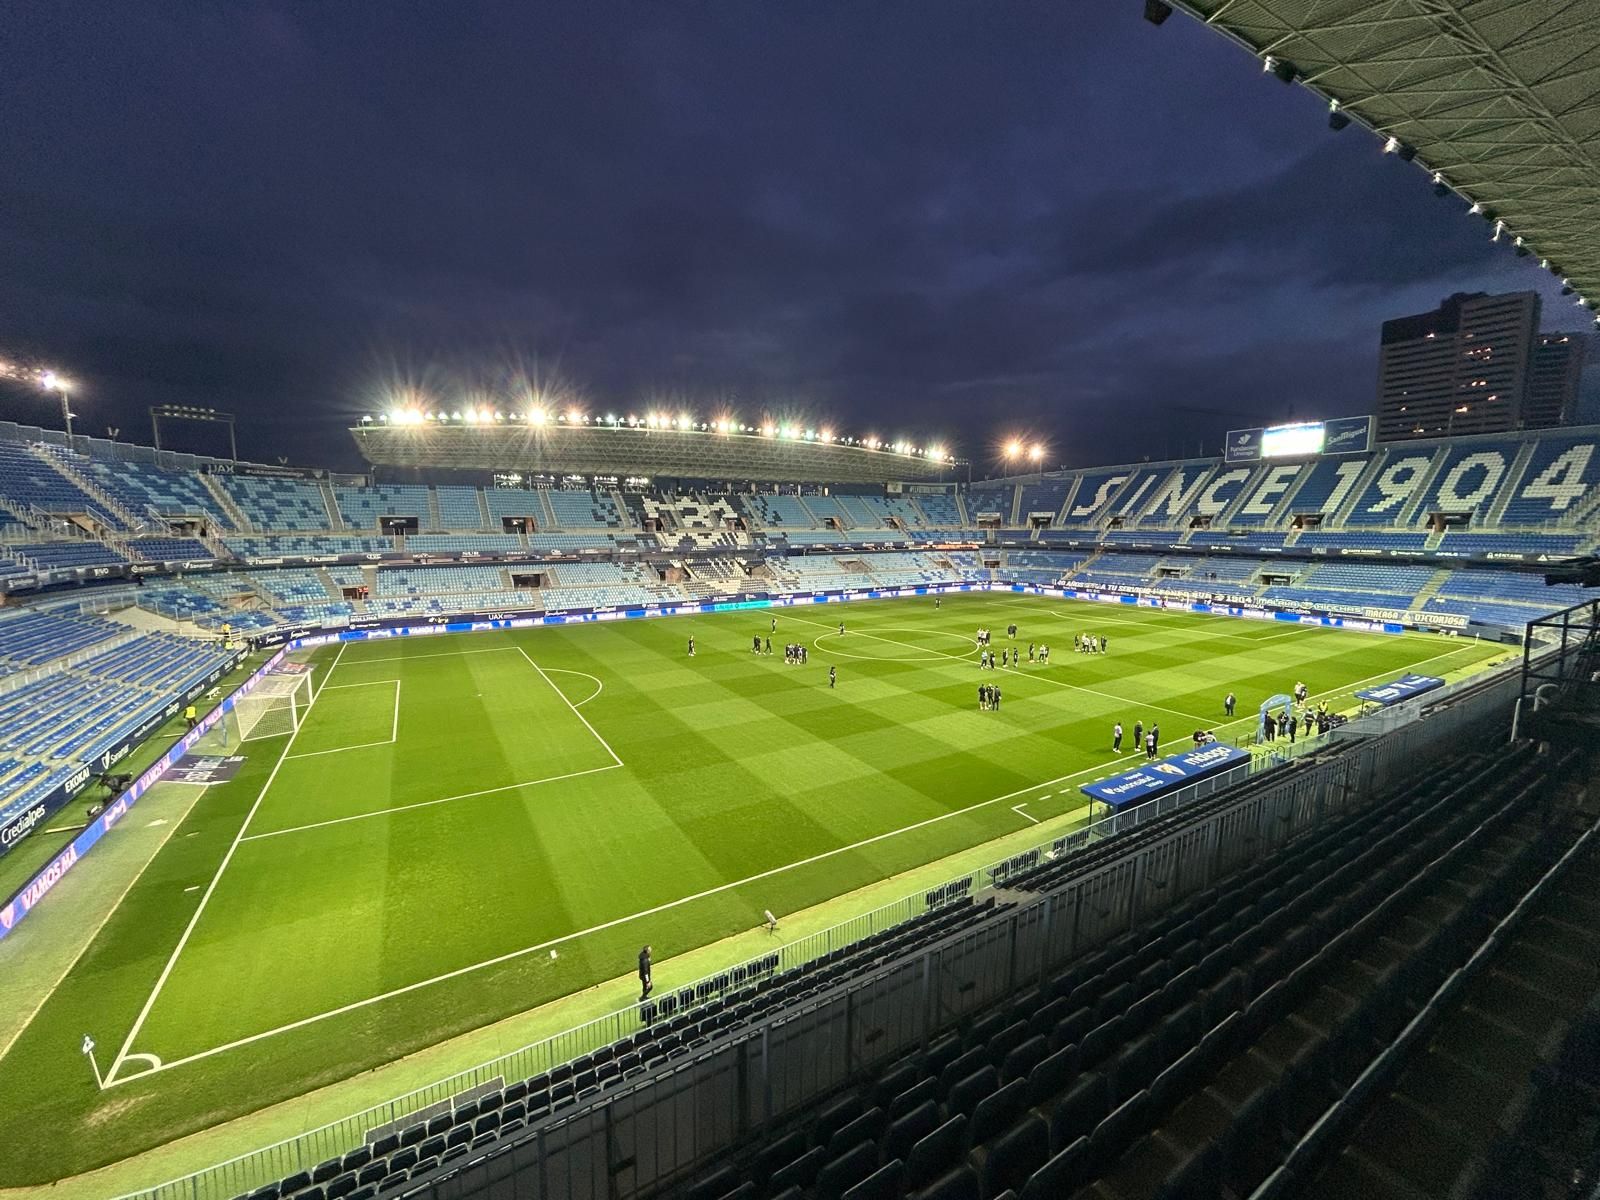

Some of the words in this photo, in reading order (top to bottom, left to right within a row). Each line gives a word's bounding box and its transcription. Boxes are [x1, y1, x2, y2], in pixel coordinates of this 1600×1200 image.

[208, 464, 234, 474] UAX
[1071, 465, 1303, 516] SINCE
[1320, 444, 1597, 514] 1904
[488, 613, 504, 621] UAX
[64, 767, 91, 793] EKOKAI
[2, 804, 46, 844] Credialpes
[21, 861, 61, 911] VAMOS
